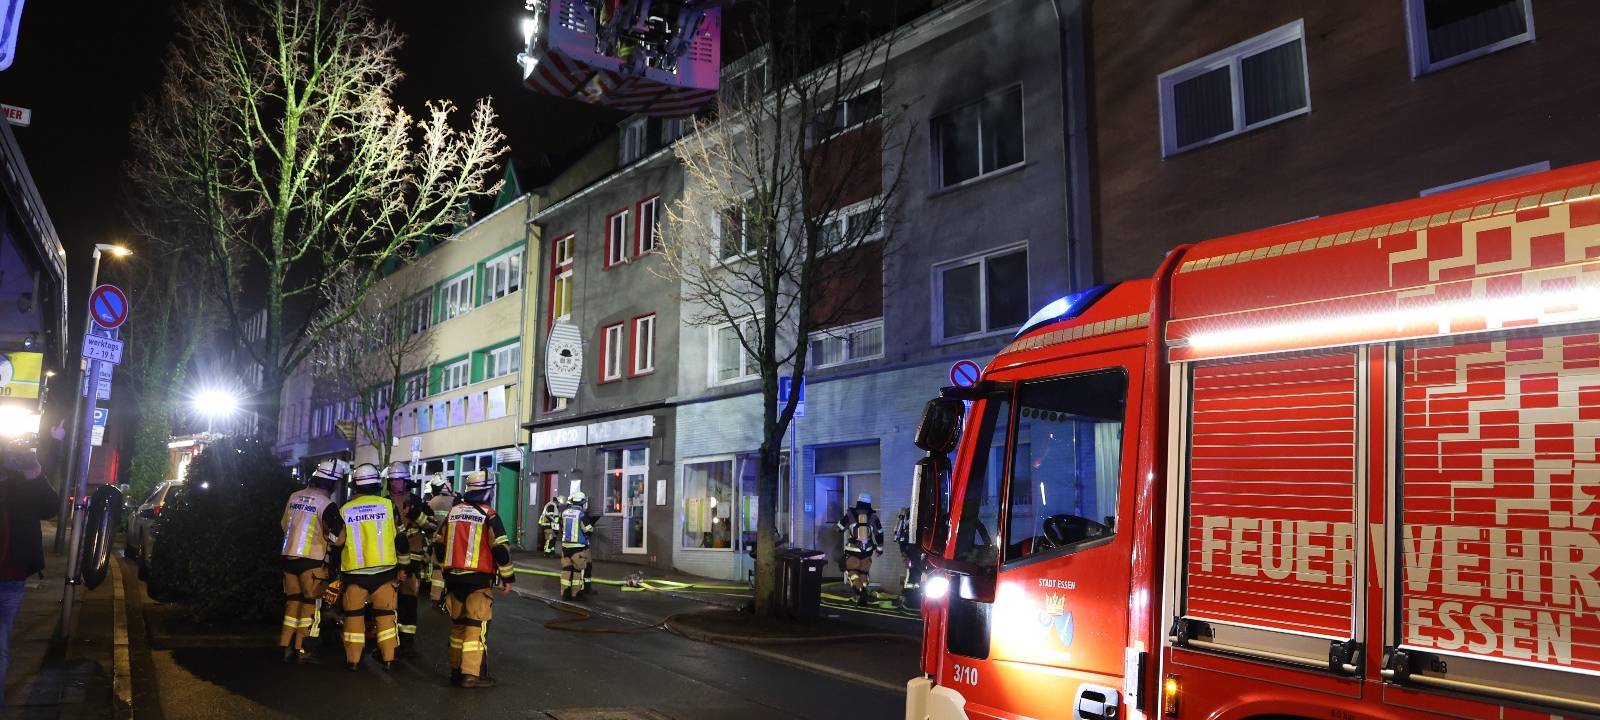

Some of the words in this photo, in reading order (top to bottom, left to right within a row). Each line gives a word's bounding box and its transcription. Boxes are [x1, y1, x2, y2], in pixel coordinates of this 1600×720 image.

[88, 338, 119, 351] werktags
[90, 348, 94, 356] 7
[101, 350, 109, 359] 19
[347, 512, 386, 523] A-DIENST
[1039, 578, 1057, 588] STADT
[1057, 580, 1076, 590] ESSEN
[1407, 598, 1573, 665] ESSEN
[953, 663, 978, 686] 3/10
